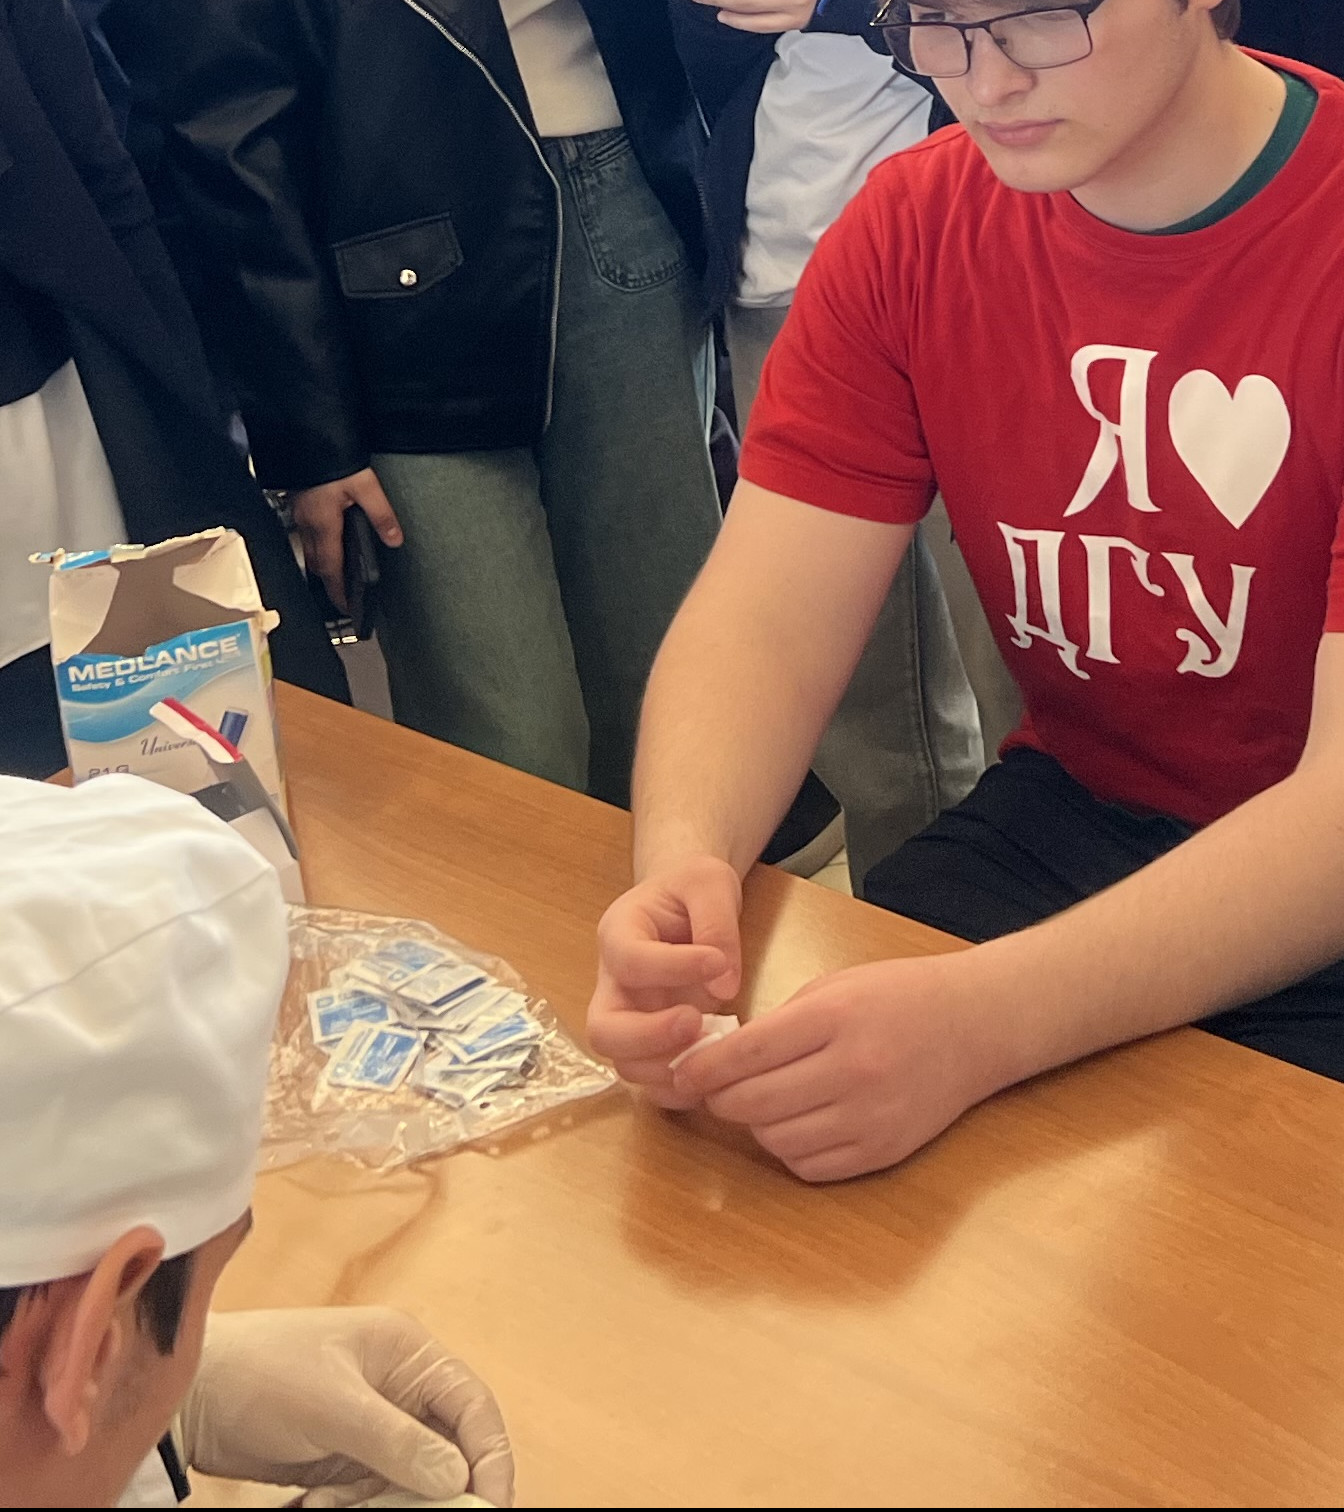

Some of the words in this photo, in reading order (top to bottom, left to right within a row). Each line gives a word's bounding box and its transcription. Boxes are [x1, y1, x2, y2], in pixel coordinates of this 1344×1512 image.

[1063, 344, 1162, 517] Я
[68, 635, 239, 683] MEDLANCE
[997, 521, 1256, 680] ДГУ
